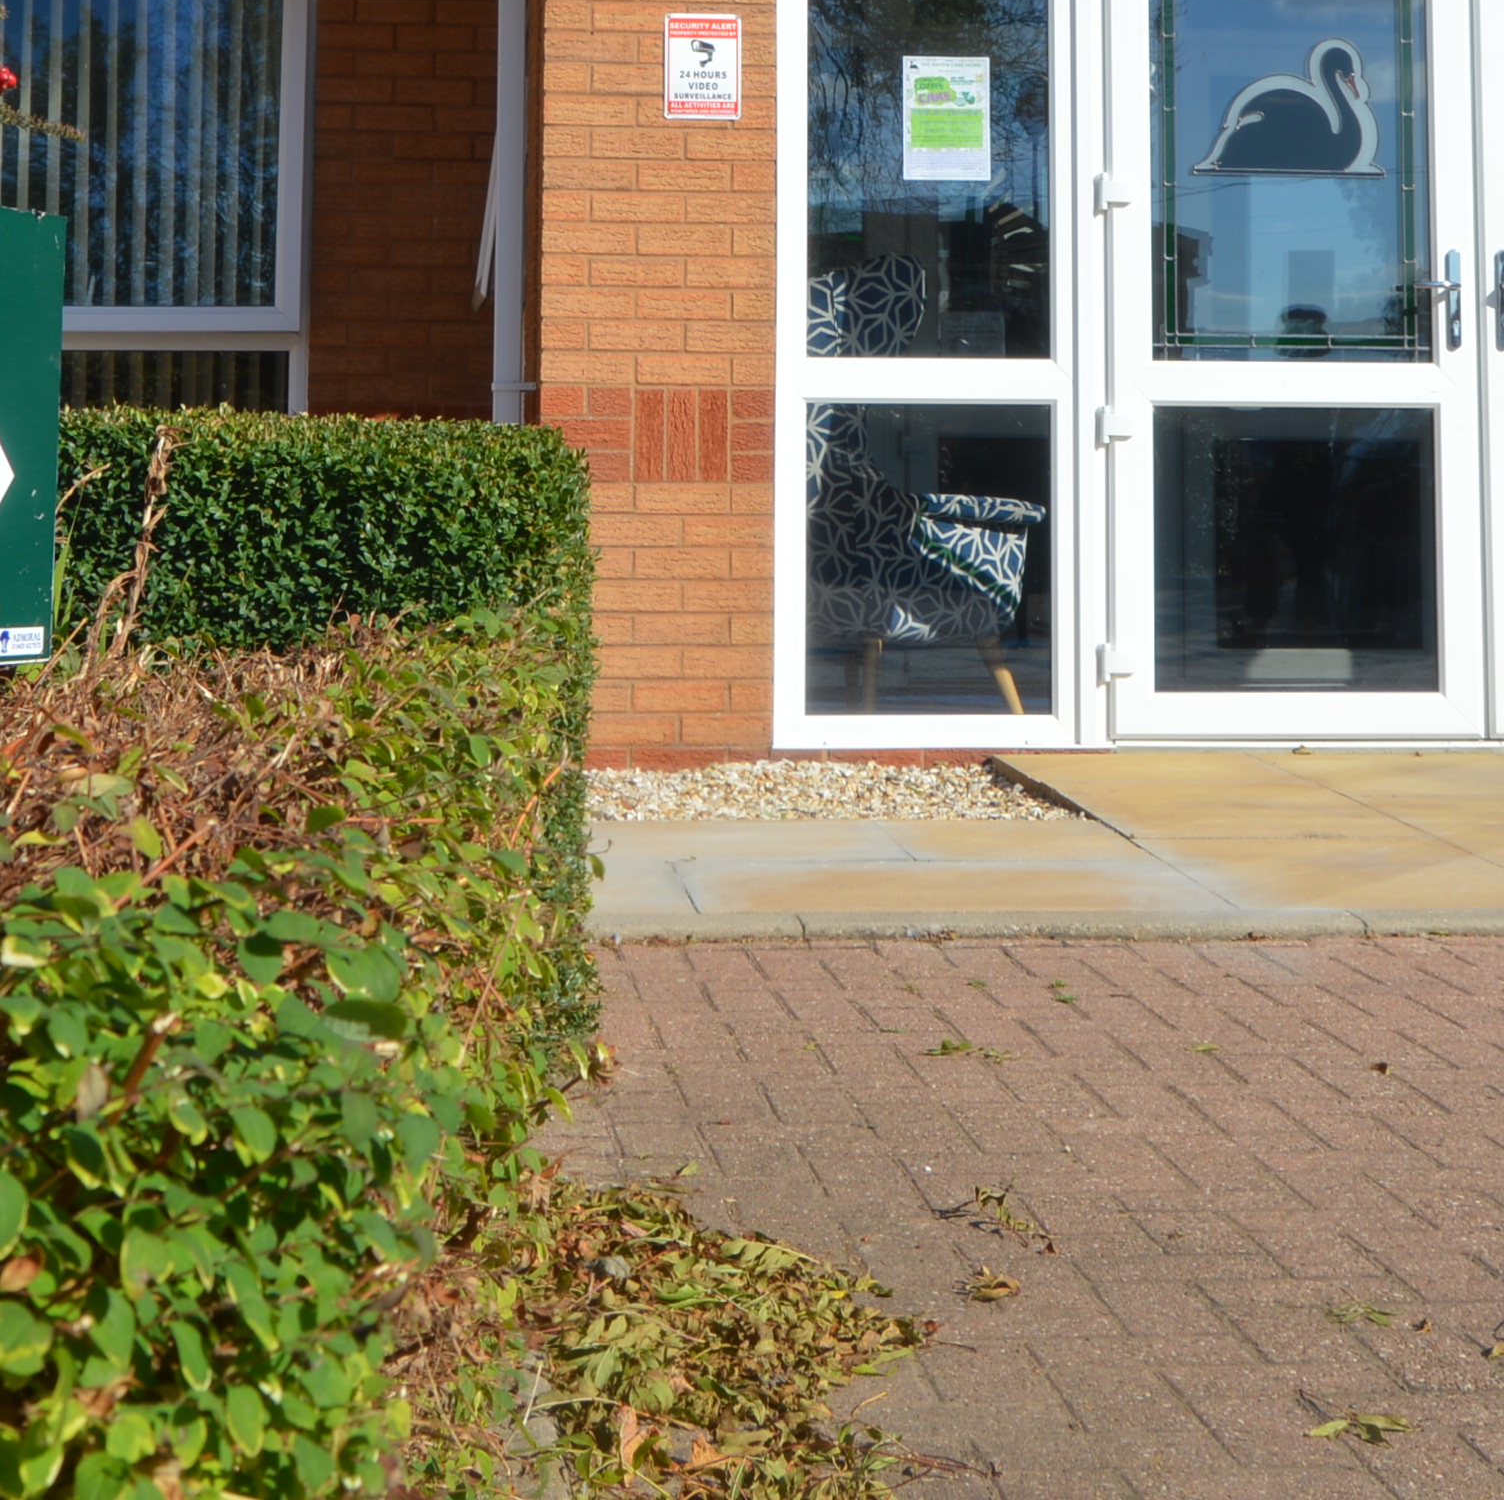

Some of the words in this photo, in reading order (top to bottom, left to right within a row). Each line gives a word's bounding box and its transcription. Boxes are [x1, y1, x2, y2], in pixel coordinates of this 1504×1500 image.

[694, 71, 727, 79] HOURS
[688, 82, 718, 90] VIDEO
[919, 92, 951, 103] CAKE
